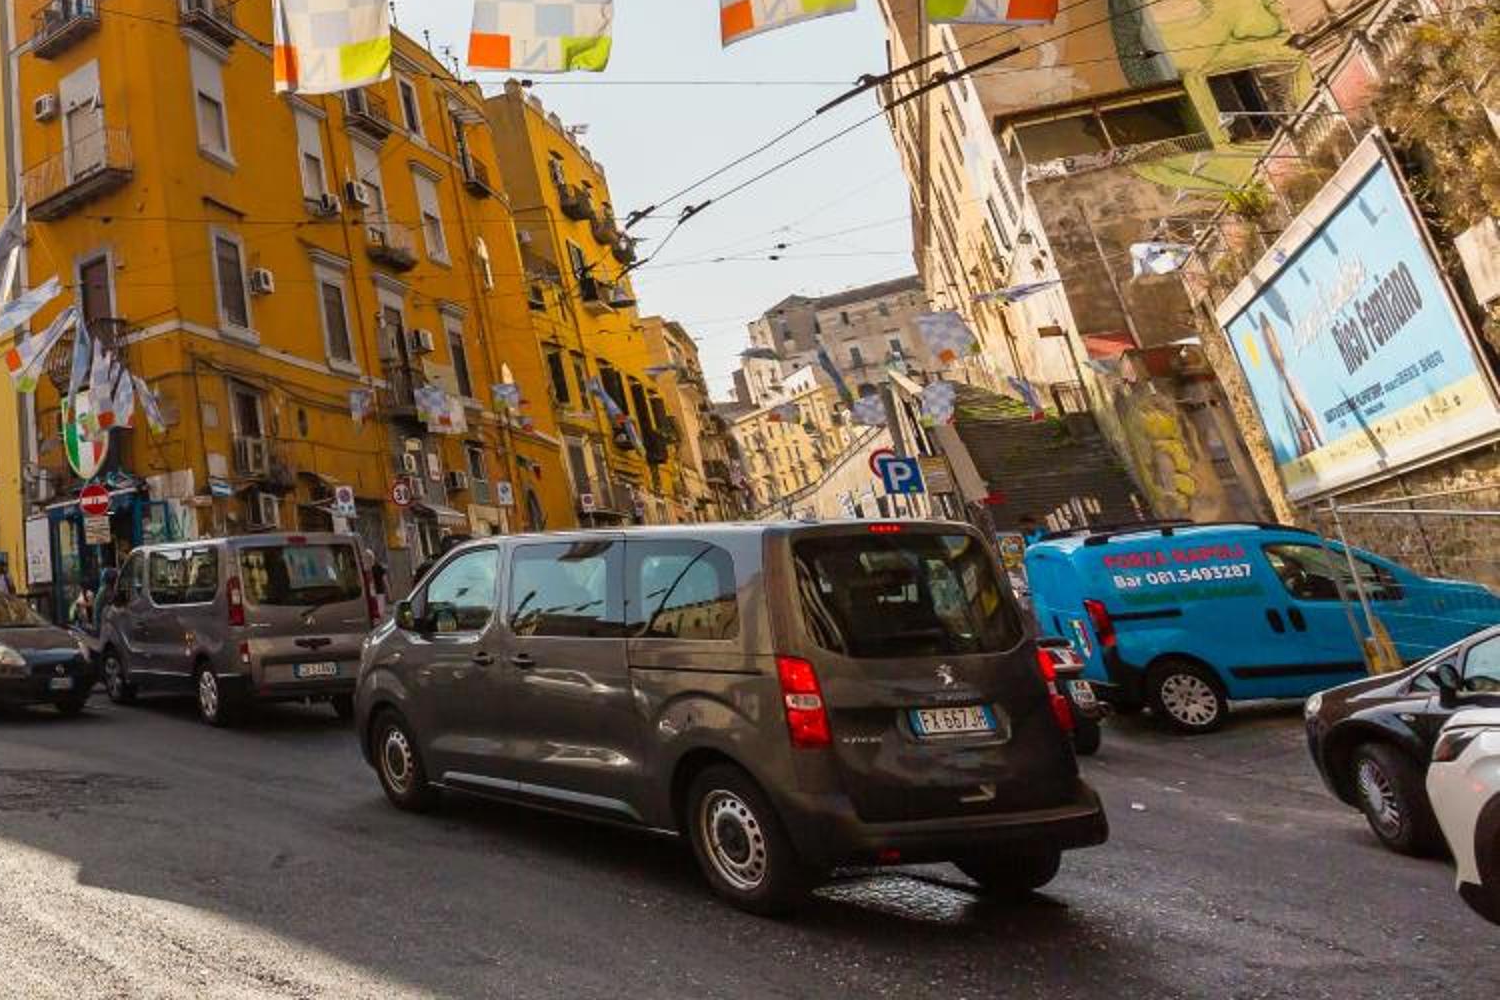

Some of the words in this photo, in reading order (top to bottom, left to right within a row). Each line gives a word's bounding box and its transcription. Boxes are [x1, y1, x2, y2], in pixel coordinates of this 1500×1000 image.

[1354, 261, 1423, 353] Femiano
[887, 461, 912, 491] P
[1113, 575, 1142, 589] Bar
